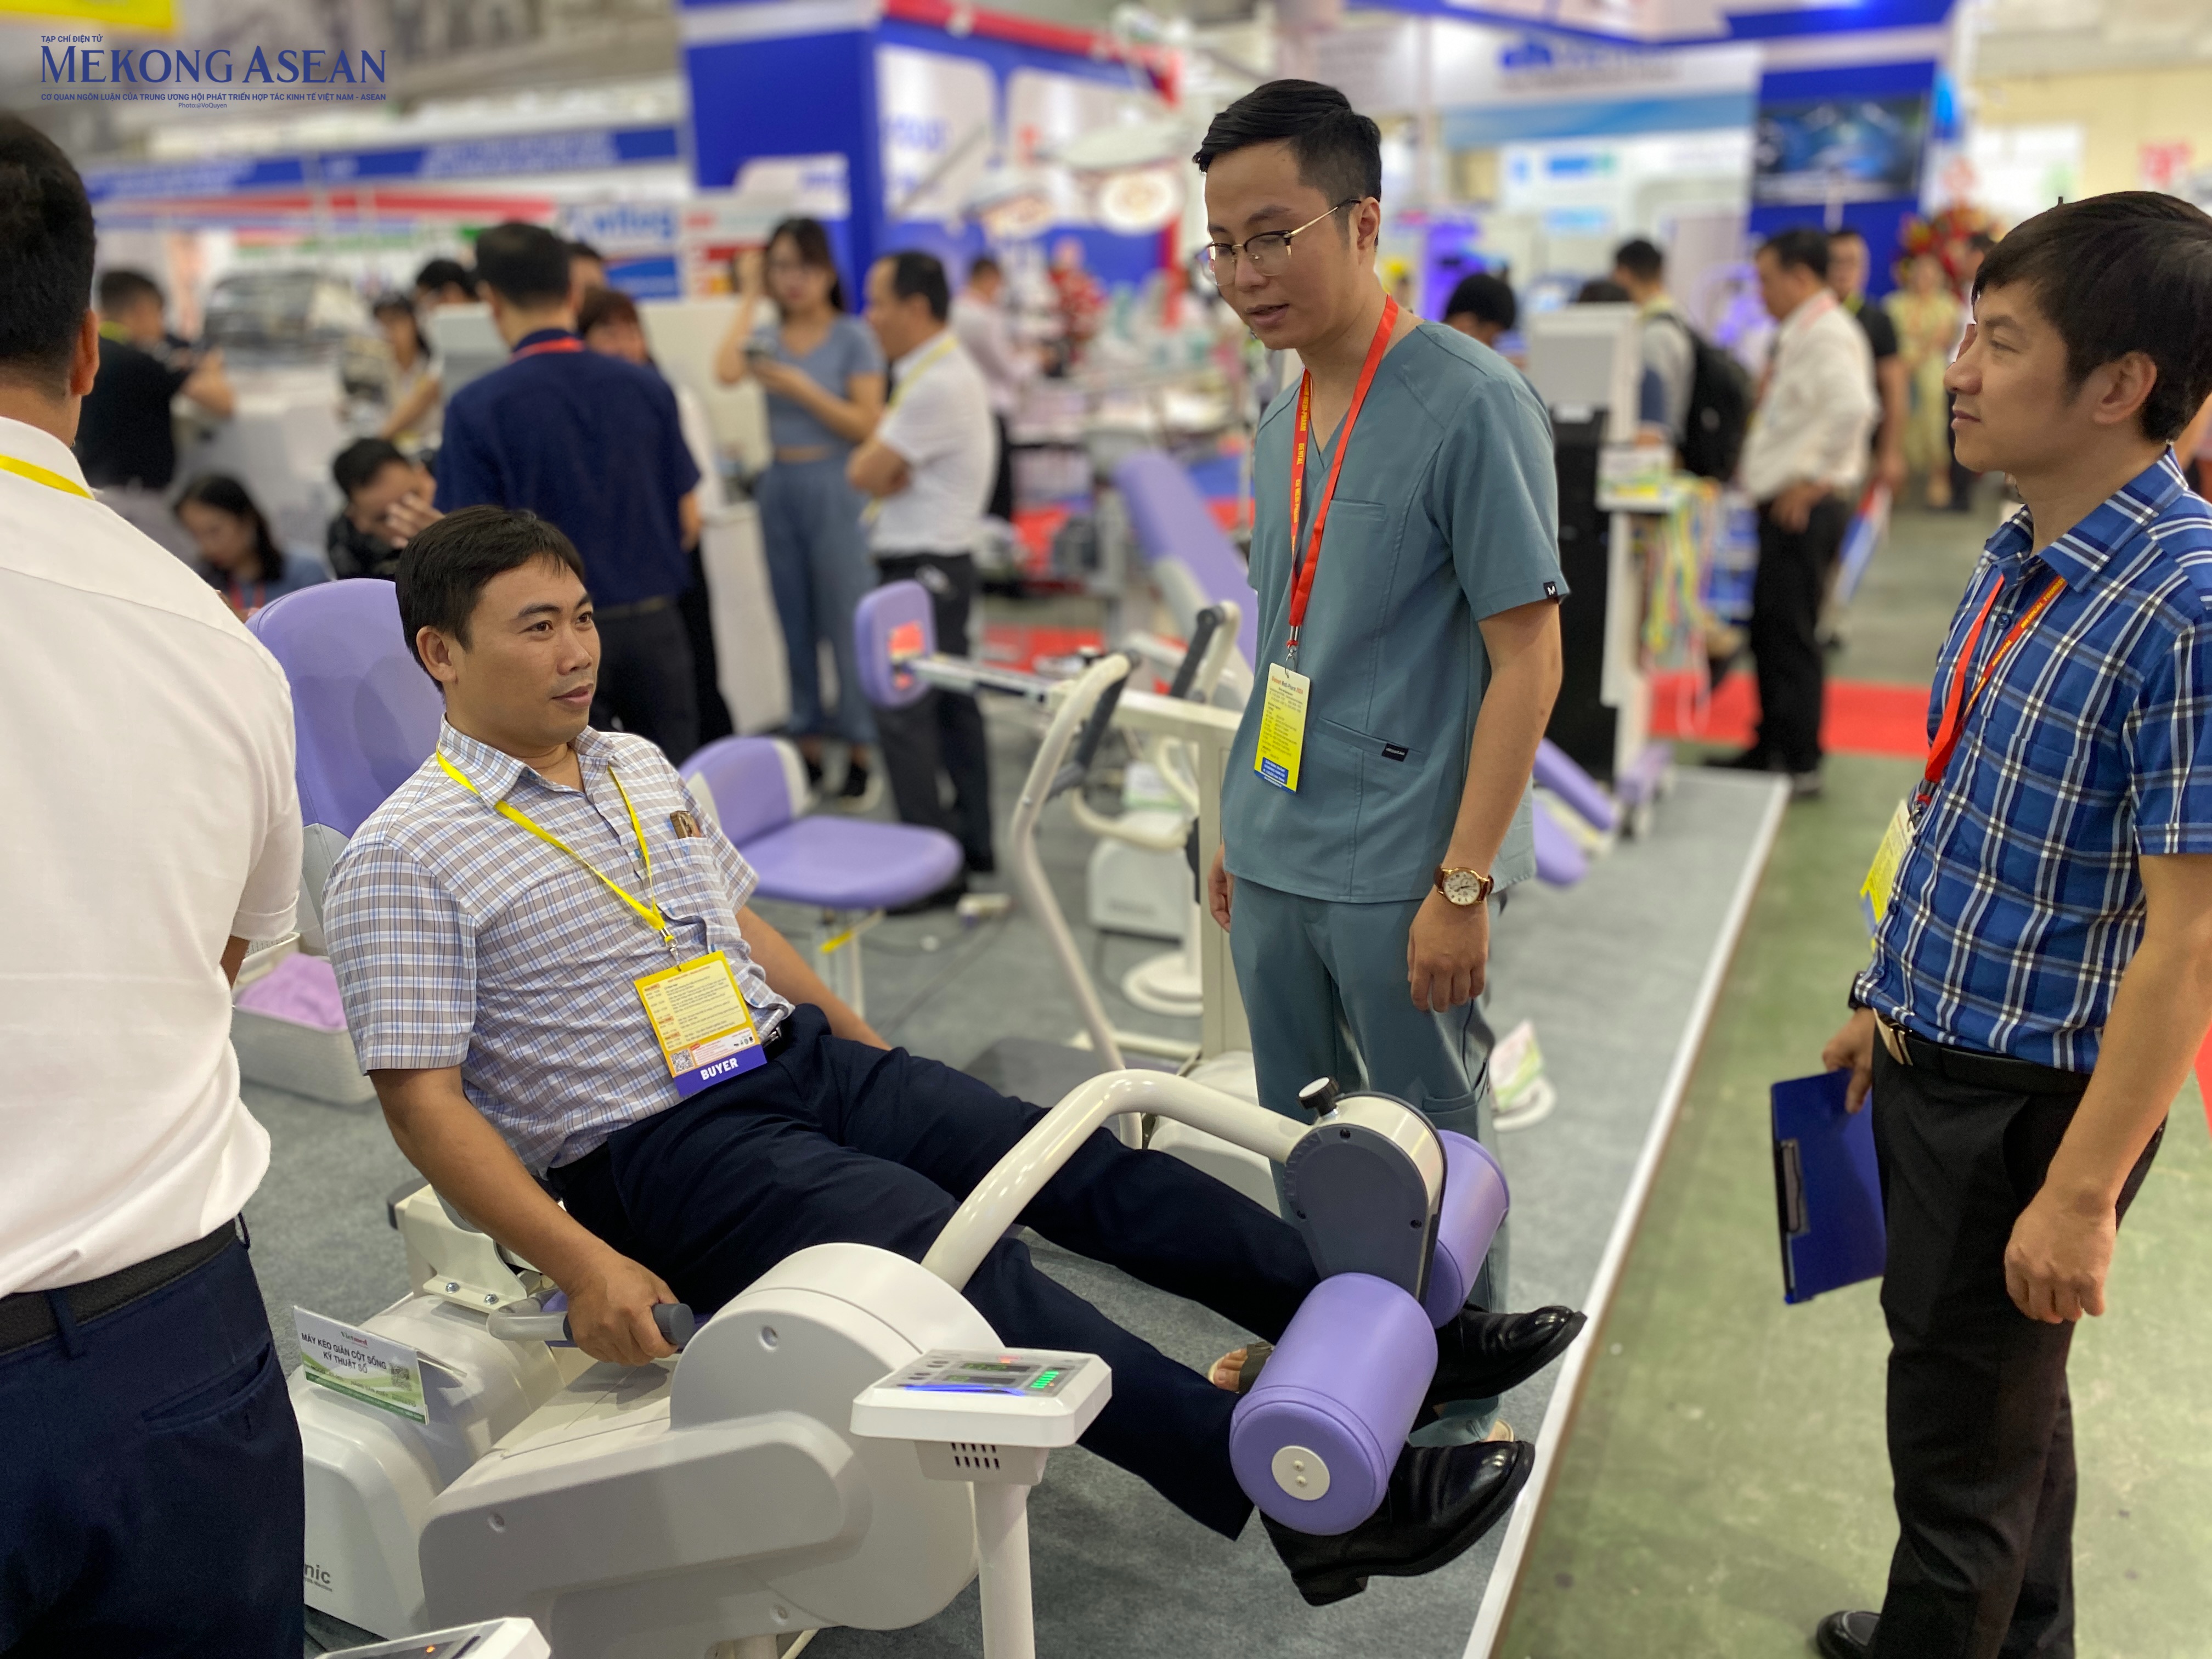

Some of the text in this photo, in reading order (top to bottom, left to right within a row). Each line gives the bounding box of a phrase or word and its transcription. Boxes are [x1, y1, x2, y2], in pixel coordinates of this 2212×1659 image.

[1296, 443, 1305, 466] DENTAL
[1547, 585, 1556, 595] M
[2021, 602, 2044, 629] MEDICAL
[2043, 577, 2066, 602] TOURIS
[699, 1057, 739, 1081] BUYER
[301, 1333, 316, 1345] MÁY
[317, 1339, 332, 1350] KÉO
[351, 1350, 365, 1362] CỘT
[367, 1355, 387, 1369] SỐNG
[358, 1363, 368, 1373] SỐ
